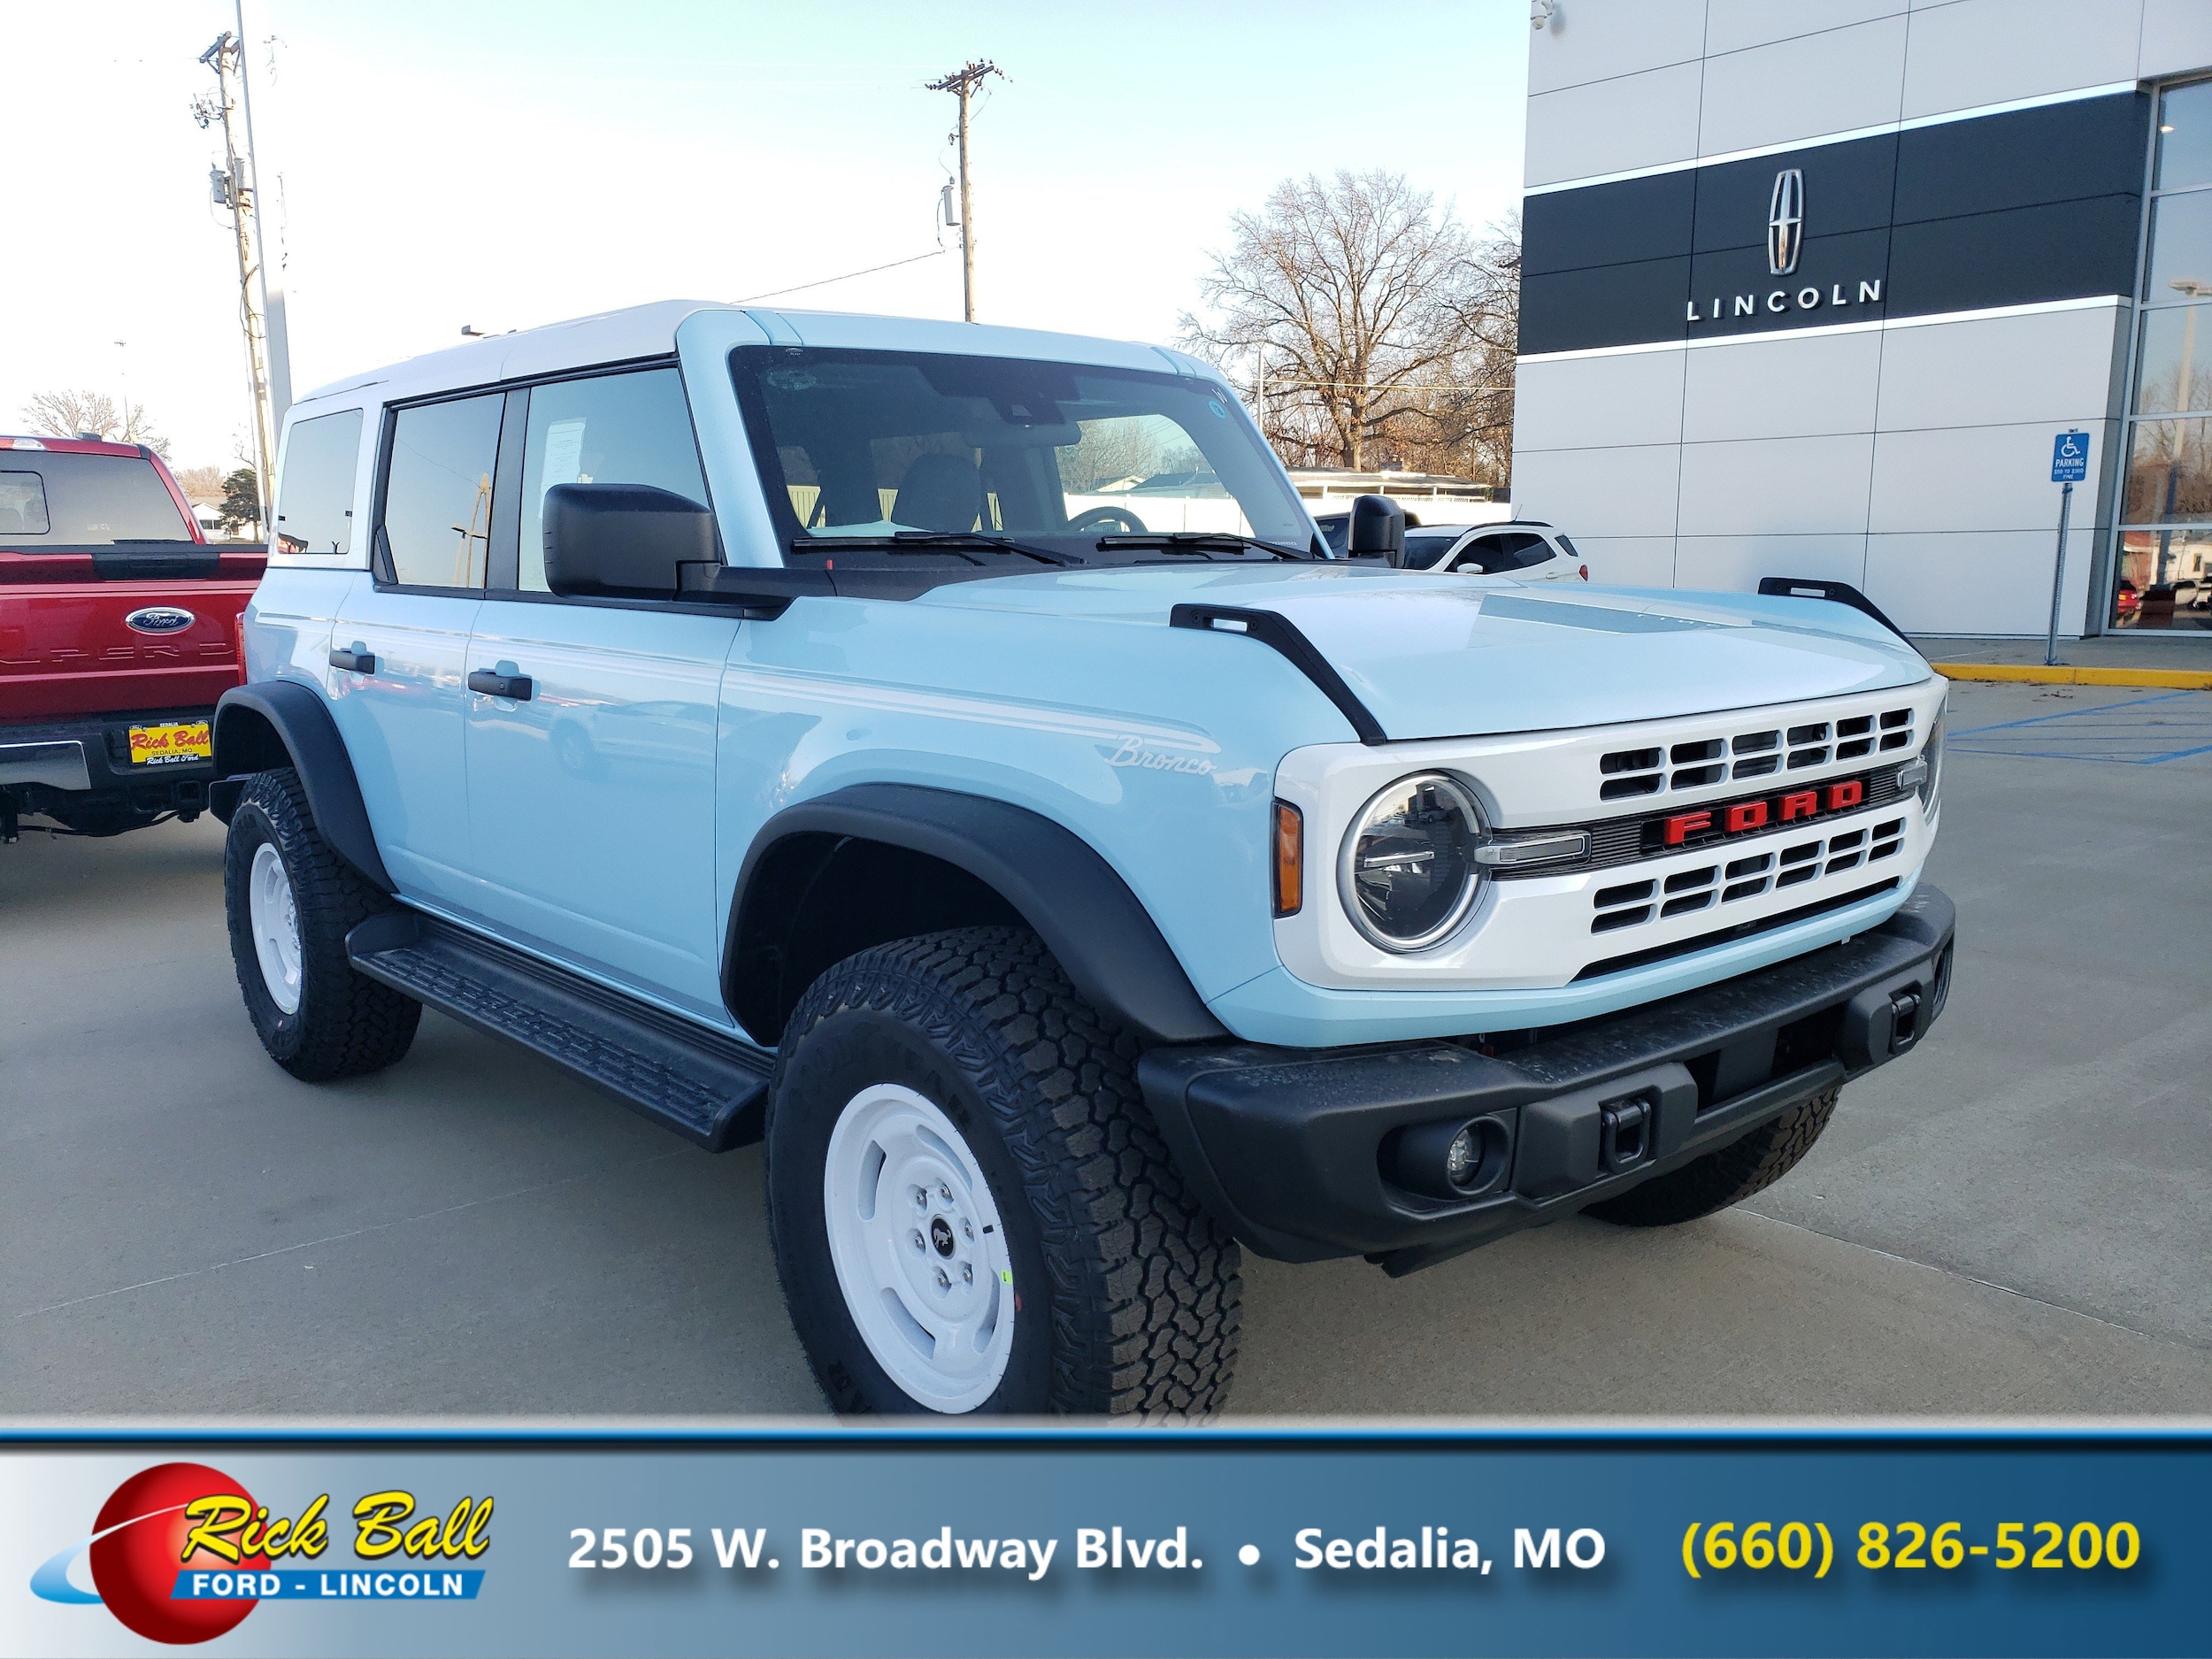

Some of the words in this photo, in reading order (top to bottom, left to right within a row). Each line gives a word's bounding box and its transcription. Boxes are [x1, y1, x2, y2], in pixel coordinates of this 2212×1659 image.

[1686, 279, 1881, 322] LINCOLN
[2055, 457, 2084, 467] PARKING
[143, 611, 179, 626] Ford
[130, 733, 170, 750] Rick
[173, 730, 209, 748] Ball
[146, 757, 164, 765] Rick
[1103, 734, 1217, 776] Bronco
[1664, 780, 1863, 845] FORD
